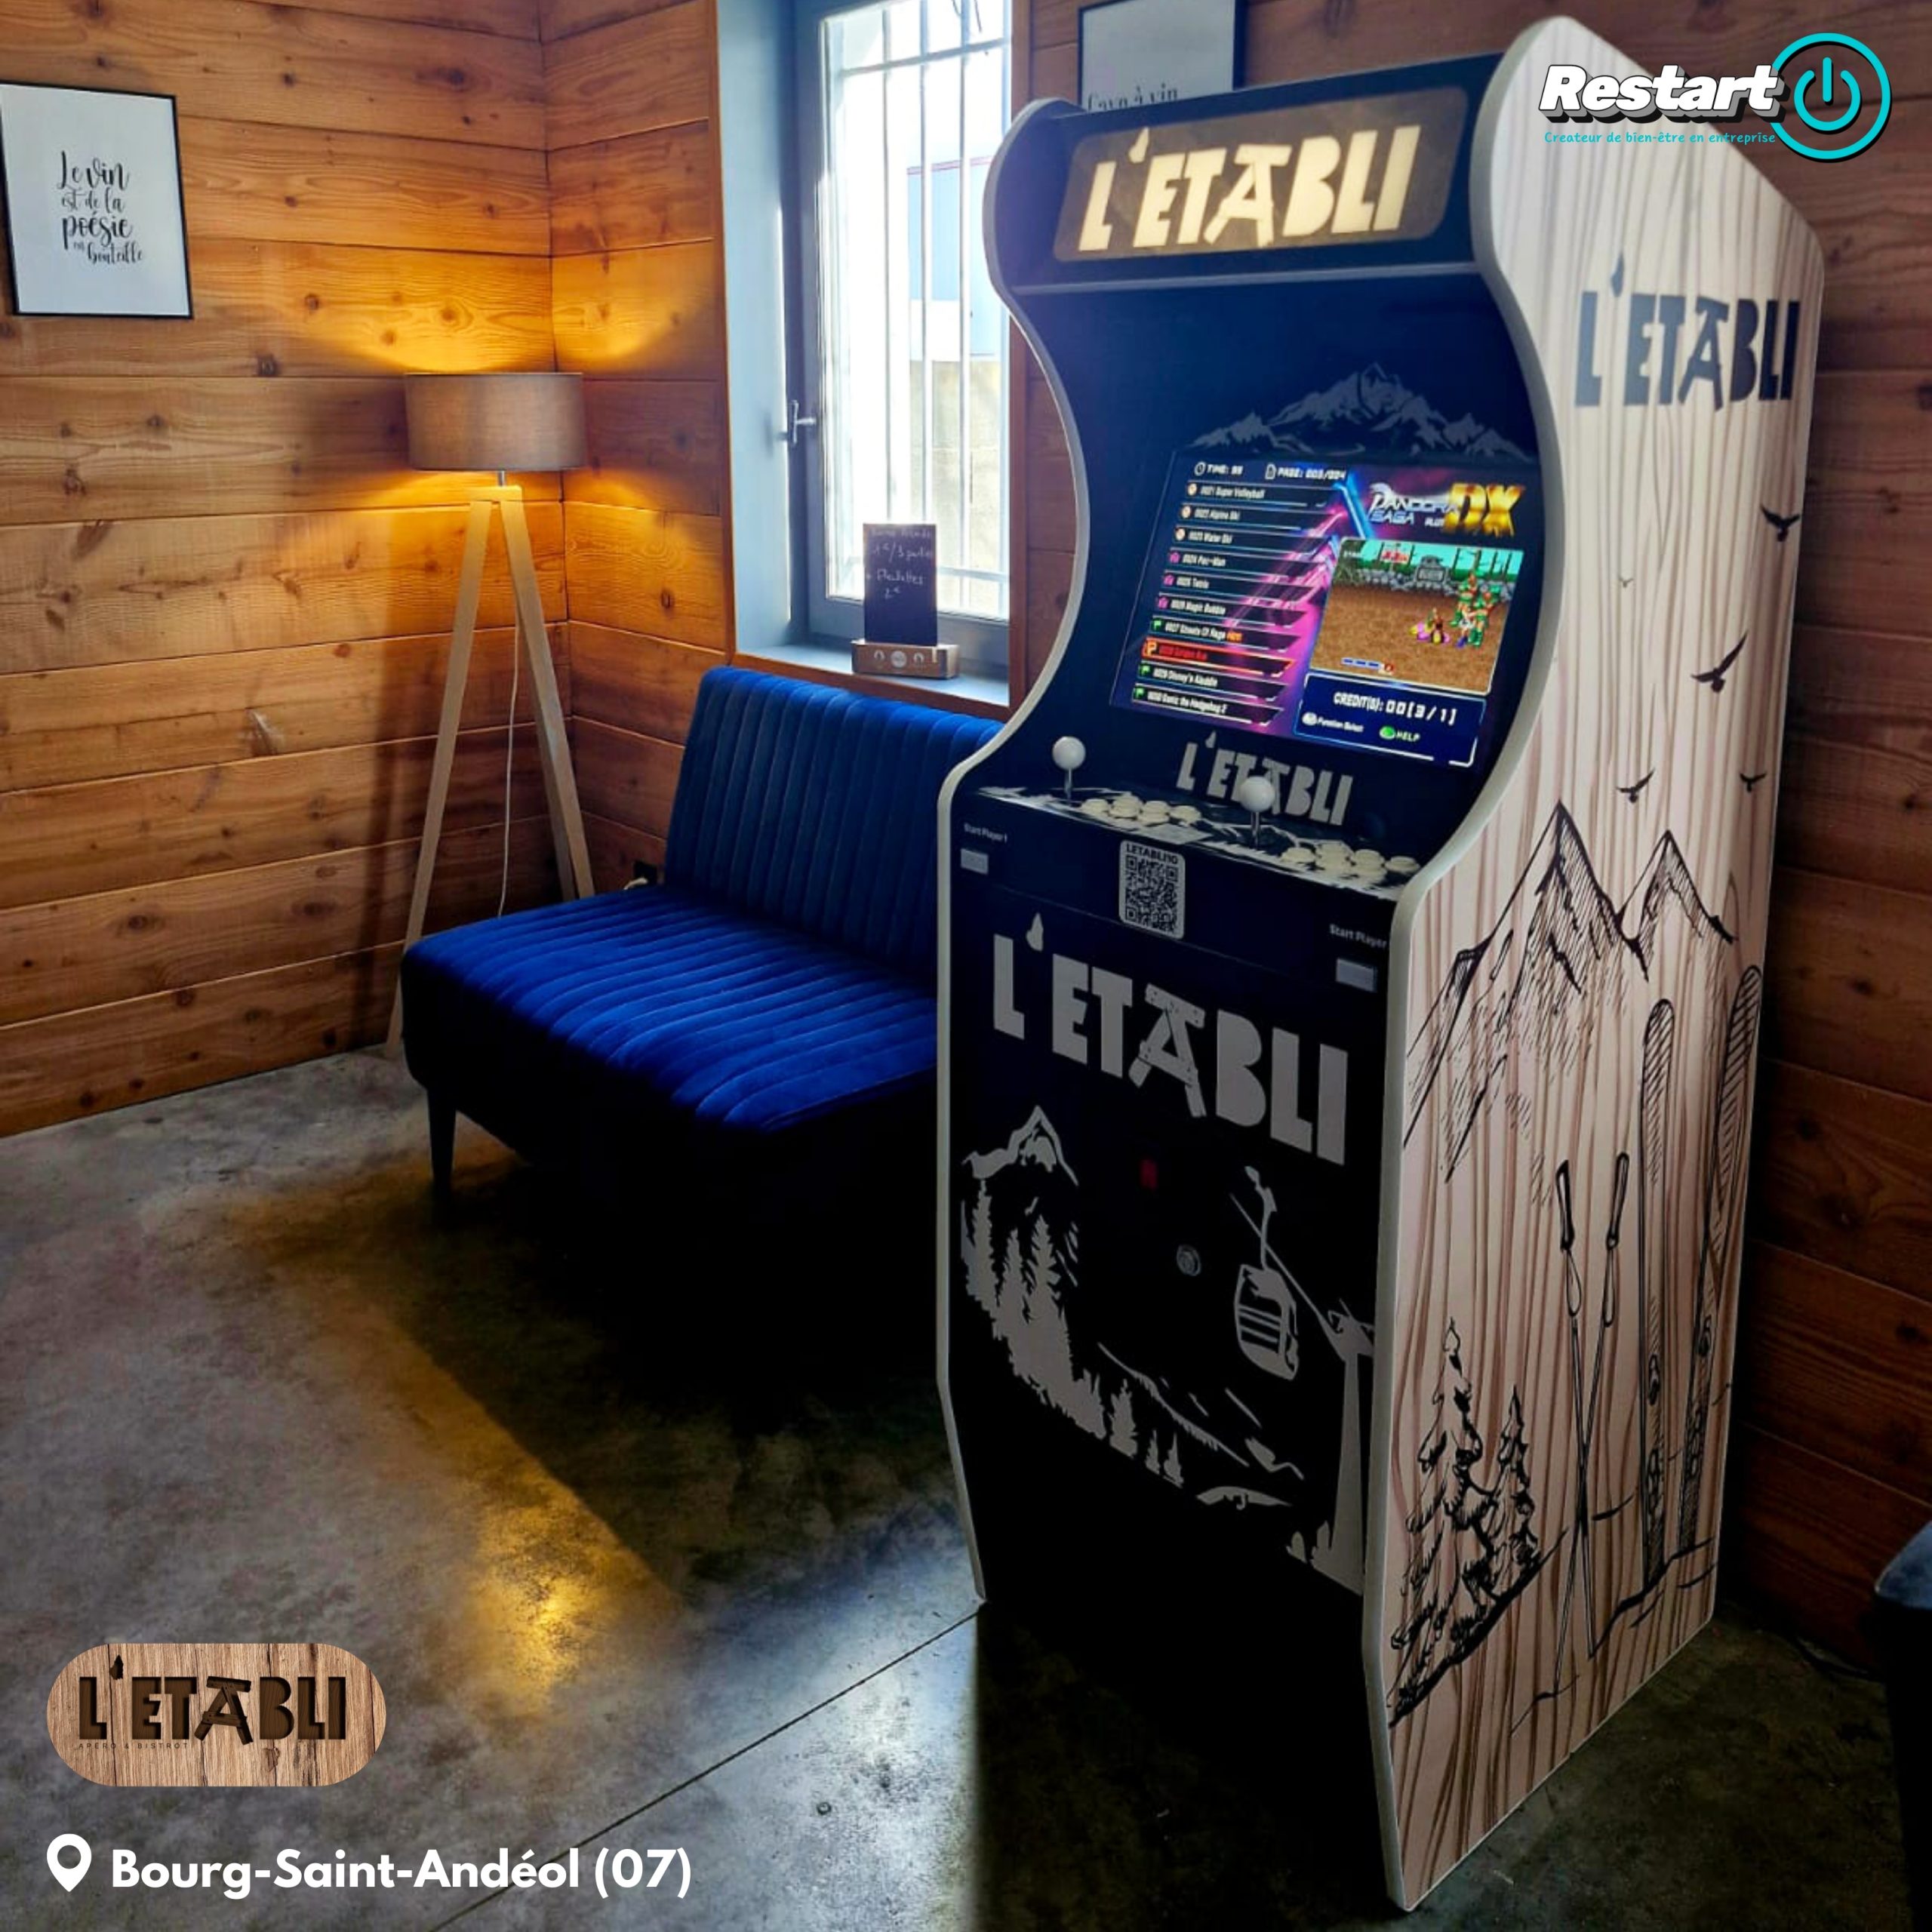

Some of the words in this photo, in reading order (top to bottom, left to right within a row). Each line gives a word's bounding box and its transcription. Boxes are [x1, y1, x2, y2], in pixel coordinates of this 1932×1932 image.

[57, 150, 83, 189] Le
[85, 157, 130, 191] vin
[1078, 127, 1422, 252] L'ETABLI
[61, 189, 86, 211] est
[85, 190, 100, 210] de
[104, 187, 125, 214] la
[62, 211, 133, 251] poésie
[87, 242, 143, 264] bouteille
[1574, 251, 1801, 412] L'ETABLI
[1369, 509, 1414, 525] SAGA
[1442, 482, 1525, 538] DX
[1396, 730, 1420, 743] HELP
[1329, 923, 1354, 940] Start
[1355, 931, 1387, 949] Player
[993, 912, 1349, 1166] L'ETABLI
